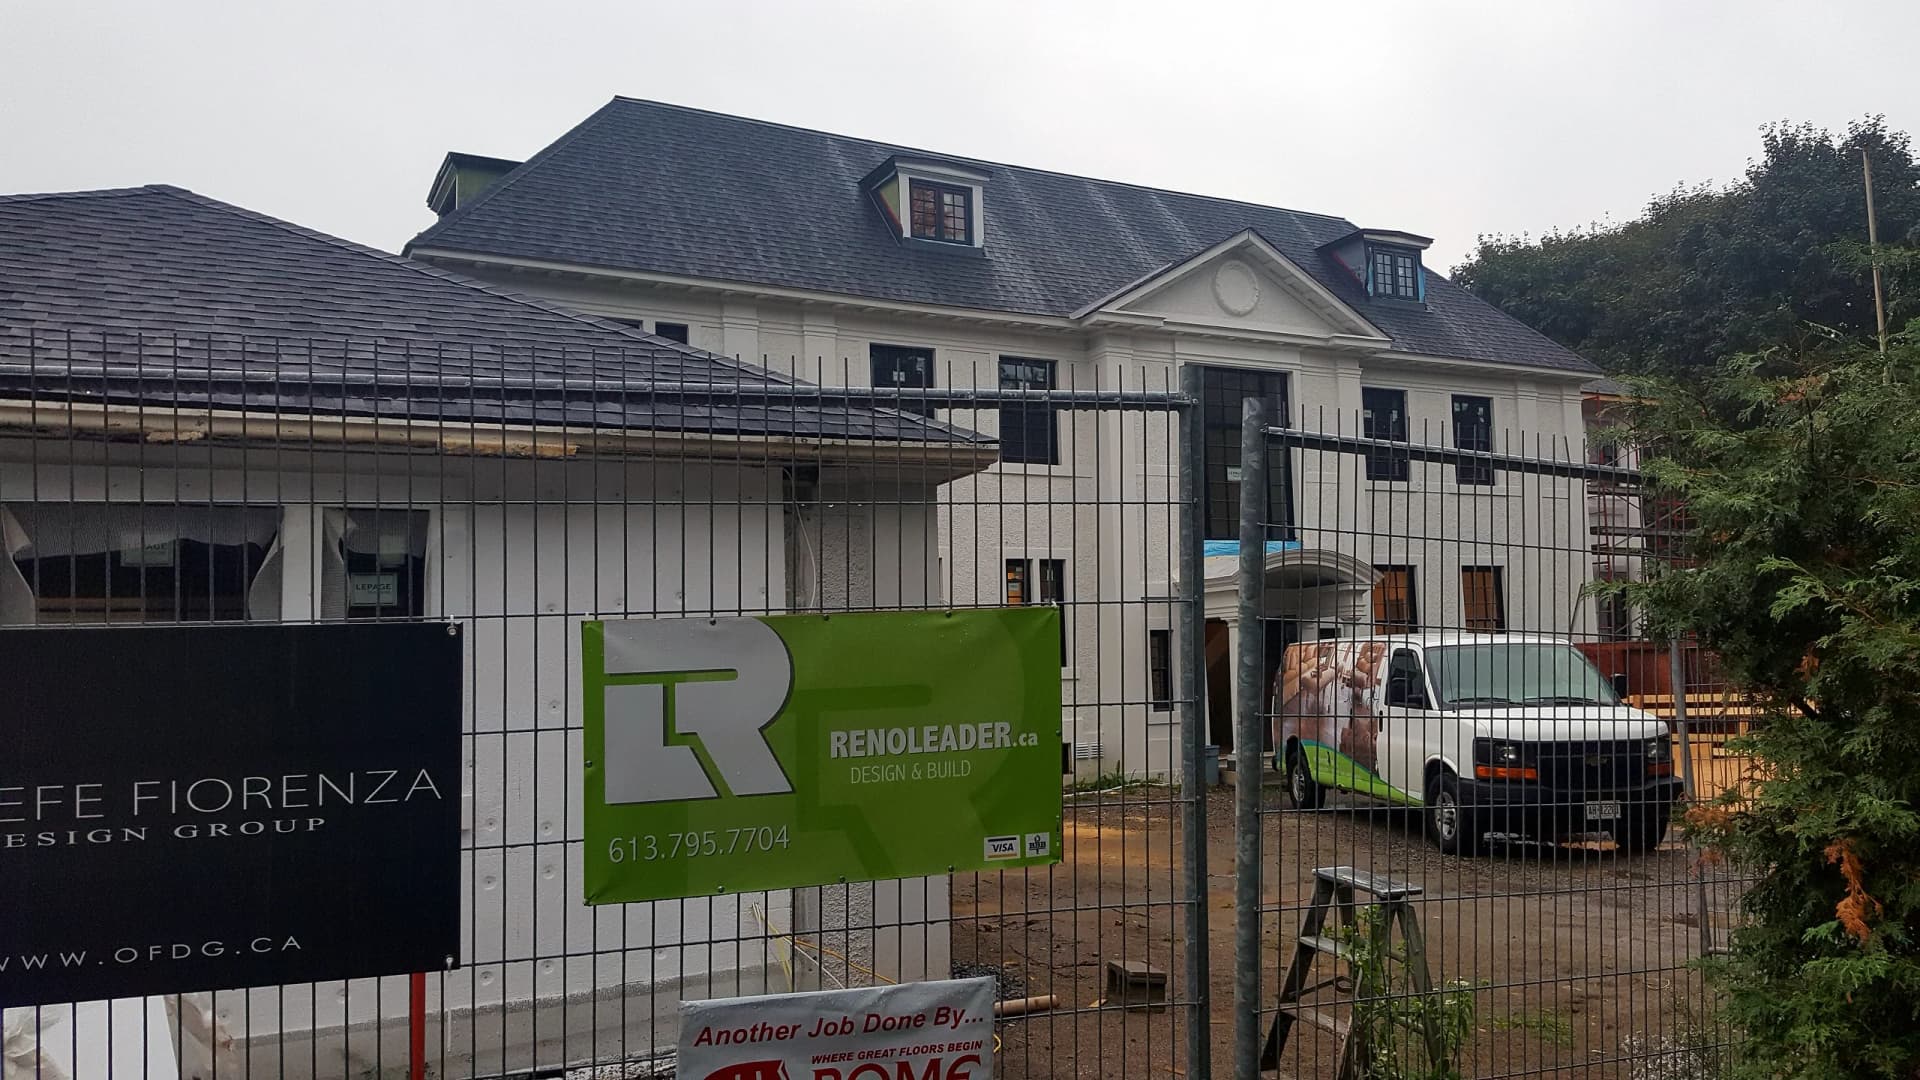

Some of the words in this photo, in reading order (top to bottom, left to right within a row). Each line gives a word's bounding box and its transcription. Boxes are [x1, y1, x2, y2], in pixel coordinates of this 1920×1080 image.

[830, 721, 1039, 759] RENOLEADER.ca
[851, 763, 906, 784] DESIGN
[911, 763, 922, 779] &
[927, 759, 971, 779] BUILD
[134, 769, 442, 816] FIORENZA
[6, 826, 147, 848] ESIGN
[174, 817, 326, 839] GROUP
[608, 825, 790, 863] 613.795.7704
[992, 843, 1014, 852] VISA
[694, 1021, 801, 1047] Another
[808, 1015, 855, 1038] Job
[863, 1012, 926, 1034] Done
[934, 1006, 984, 1030] By...
[812, 1051, 854, 1064] WHERE
[857, 1048, 897, 1060] GREAT
[898, 1043, 944, 1057] FLOORS
[947, 1039, 983, 1052] BEGIN
